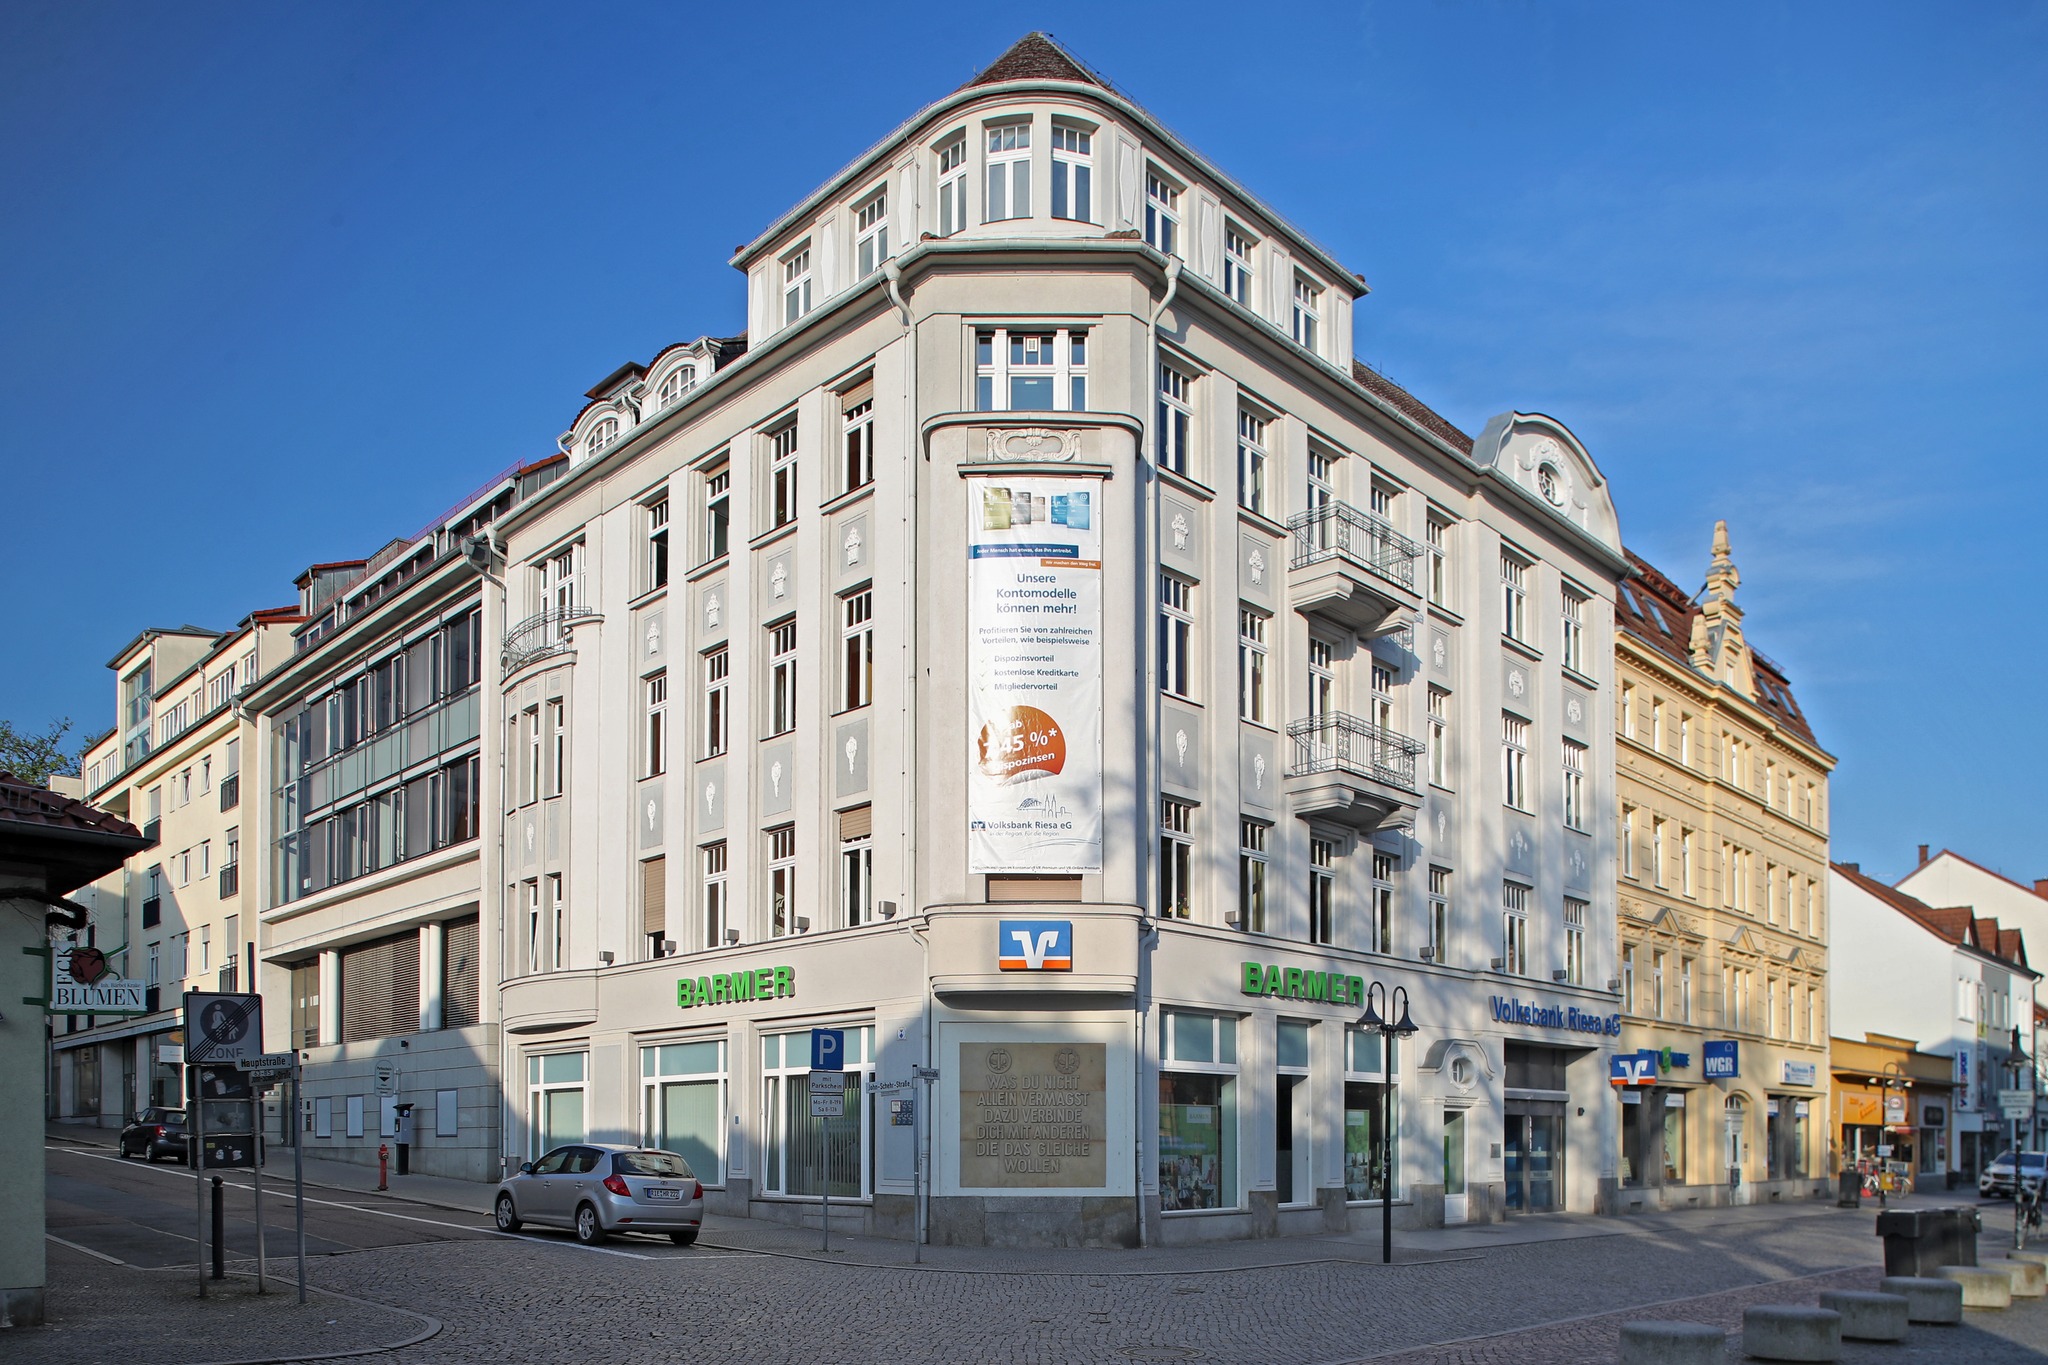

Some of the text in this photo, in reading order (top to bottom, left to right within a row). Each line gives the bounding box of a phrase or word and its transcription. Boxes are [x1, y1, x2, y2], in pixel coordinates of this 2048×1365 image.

[1017, 574, 1056, 583] Unsere
[996, 588, 1077, 599] Kontomodelle
[996, 603, 1077, 614] können mehr!
[979, 626, 1018, 635] Profitieren
[1050, 627, 1093, 635] zahlreichen
[982, 636, 1018, 644] Vorteilen,
[1036, 636, 1090, 645] beispielsweise
[994, 655, 1055, 663] Dispozinsvorteil
[1036, 669, 1079, 677] Kreditkarte
[994, 683, 1058, 691] Mitgliedervorteil
[988, 821, 1072, 829] Volksbank Riesa eG
[677, 966, 794, 1007] BARMER
[1243, 961, 1364, 1005] BARMER
[57, 988, 141, 1005] BLUMEN
[1489, 995, 1621, 1037] Volksbank Riesa eG
[819, 1034, 837, 1065] P
[241, 1056, 286, 1069] Hauptstraße
[1706, 1057, 1733, 1073] WGR
[986, 1075, 1080, 1090] WAS DU NICHT
[976, 1092, 1090, 1107] ALLEIN VERMAGST
[984, 1108, 1082, 1123] DAZU VERBINDE
[976, 1125, 1090, 1140] DICH MIT ANDEREN
[976, 1142, 1090, 1156] DIE DAS GLEICHE
[1004, 1158, 1060, 1174] WOLLEN
